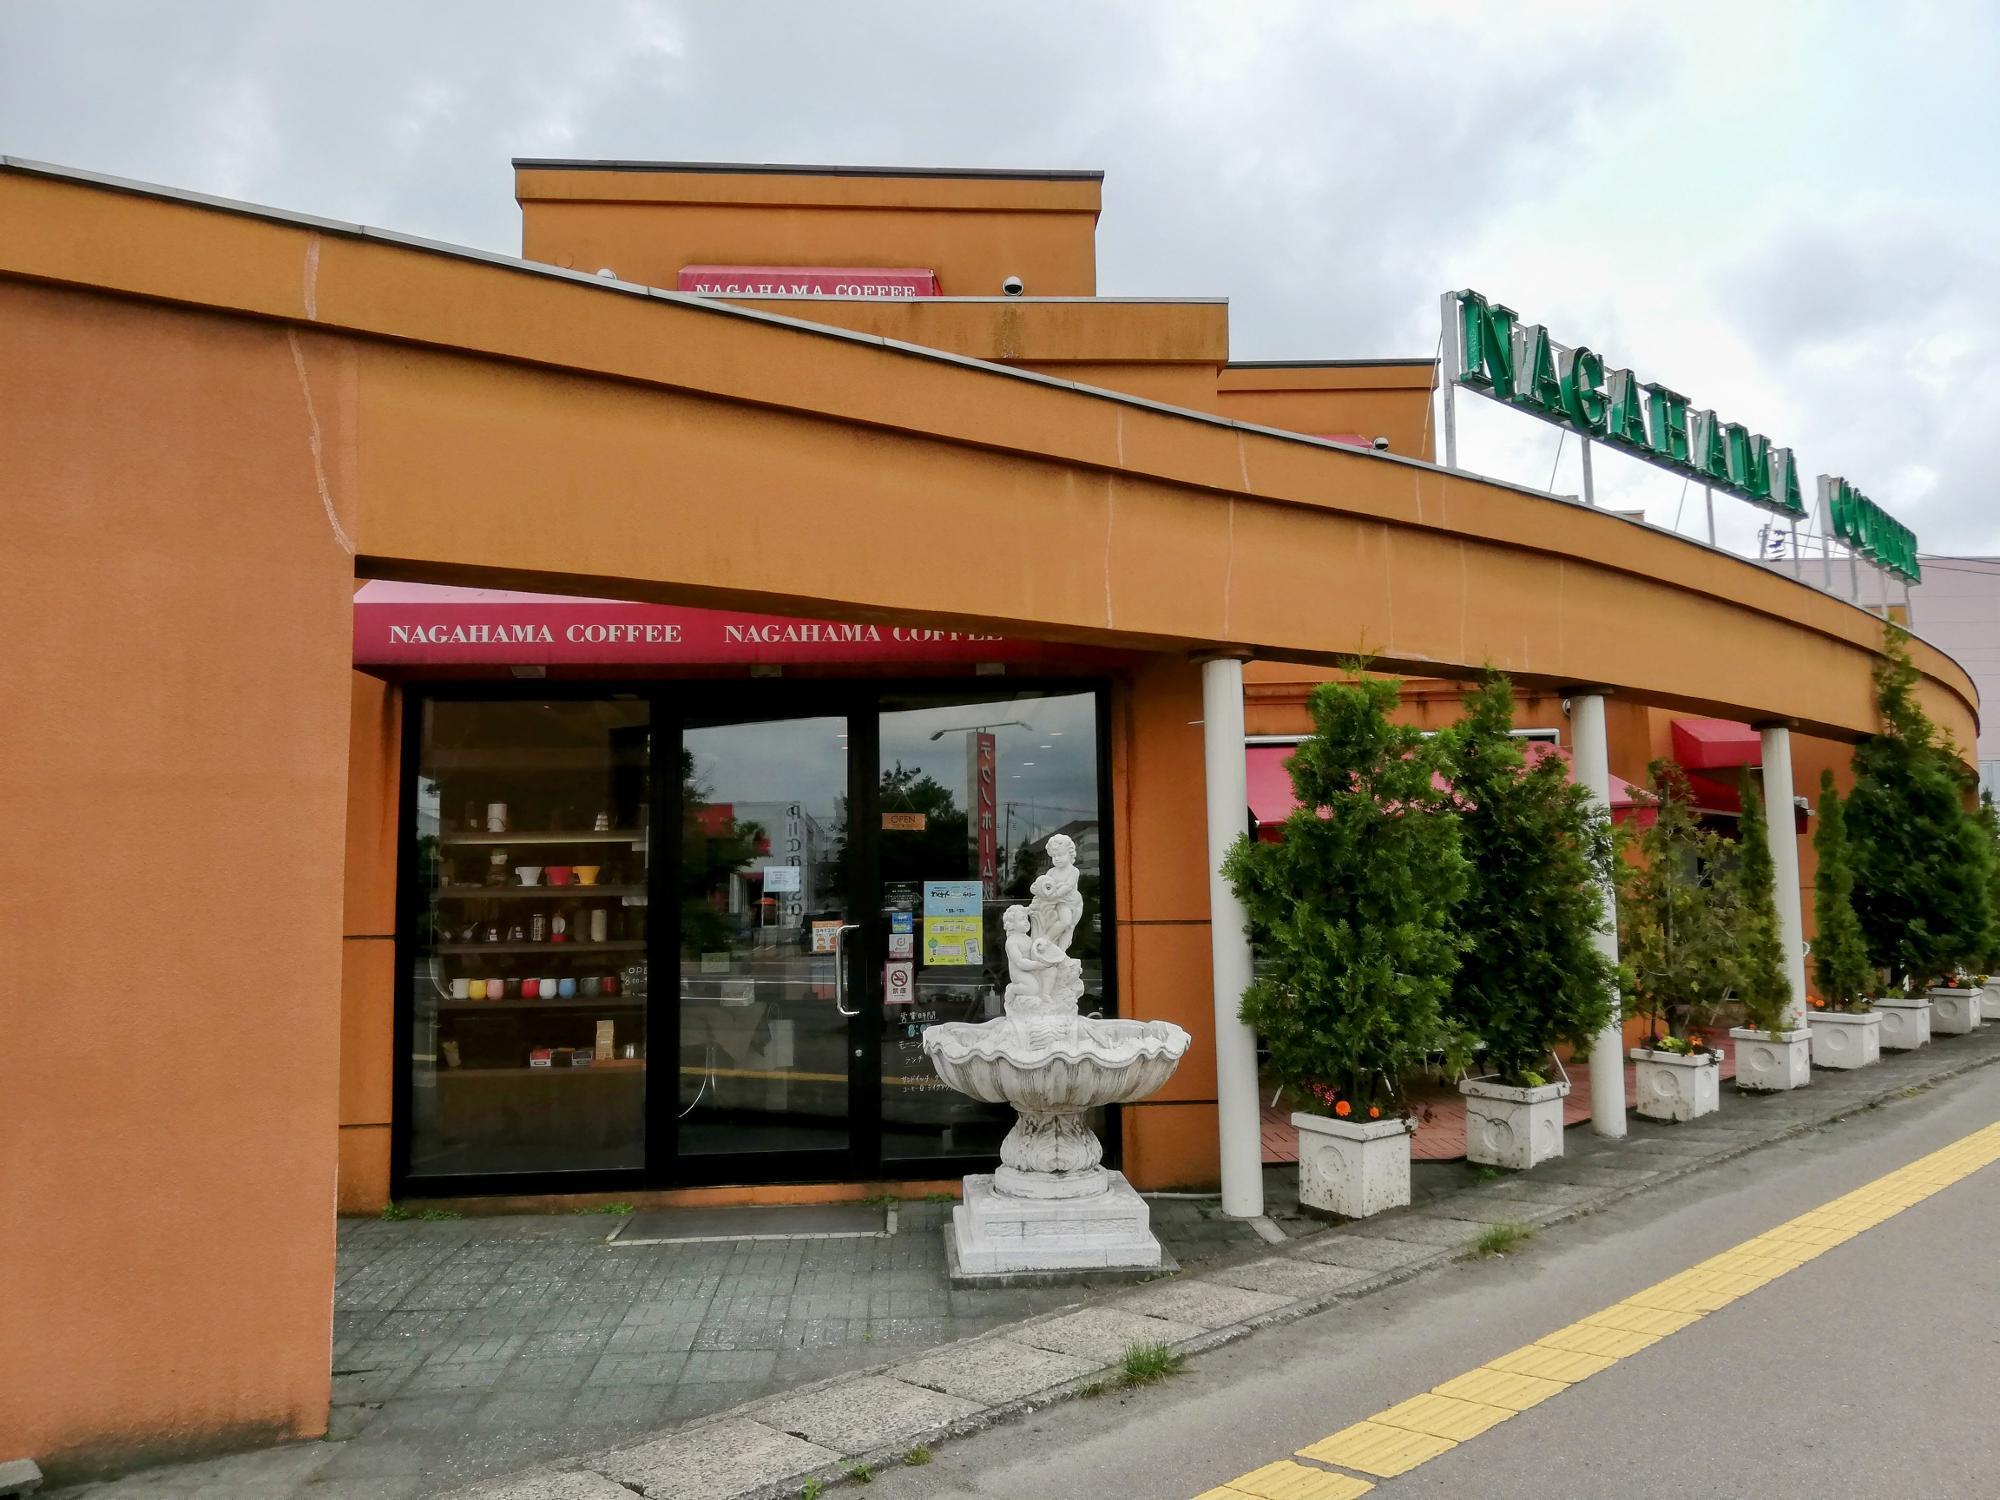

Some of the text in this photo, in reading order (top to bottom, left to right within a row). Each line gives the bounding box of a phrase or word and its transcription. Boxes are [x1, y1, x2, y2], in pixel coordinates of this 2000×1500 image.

[1456, 288, 1808, 519] NAGAHAMA
[388, 624, 682, 644] NAGAHAMA COFFEE
[724, 624, 881, 643] NAGAHAMA
[890, 815, 916, 824] OPEN
